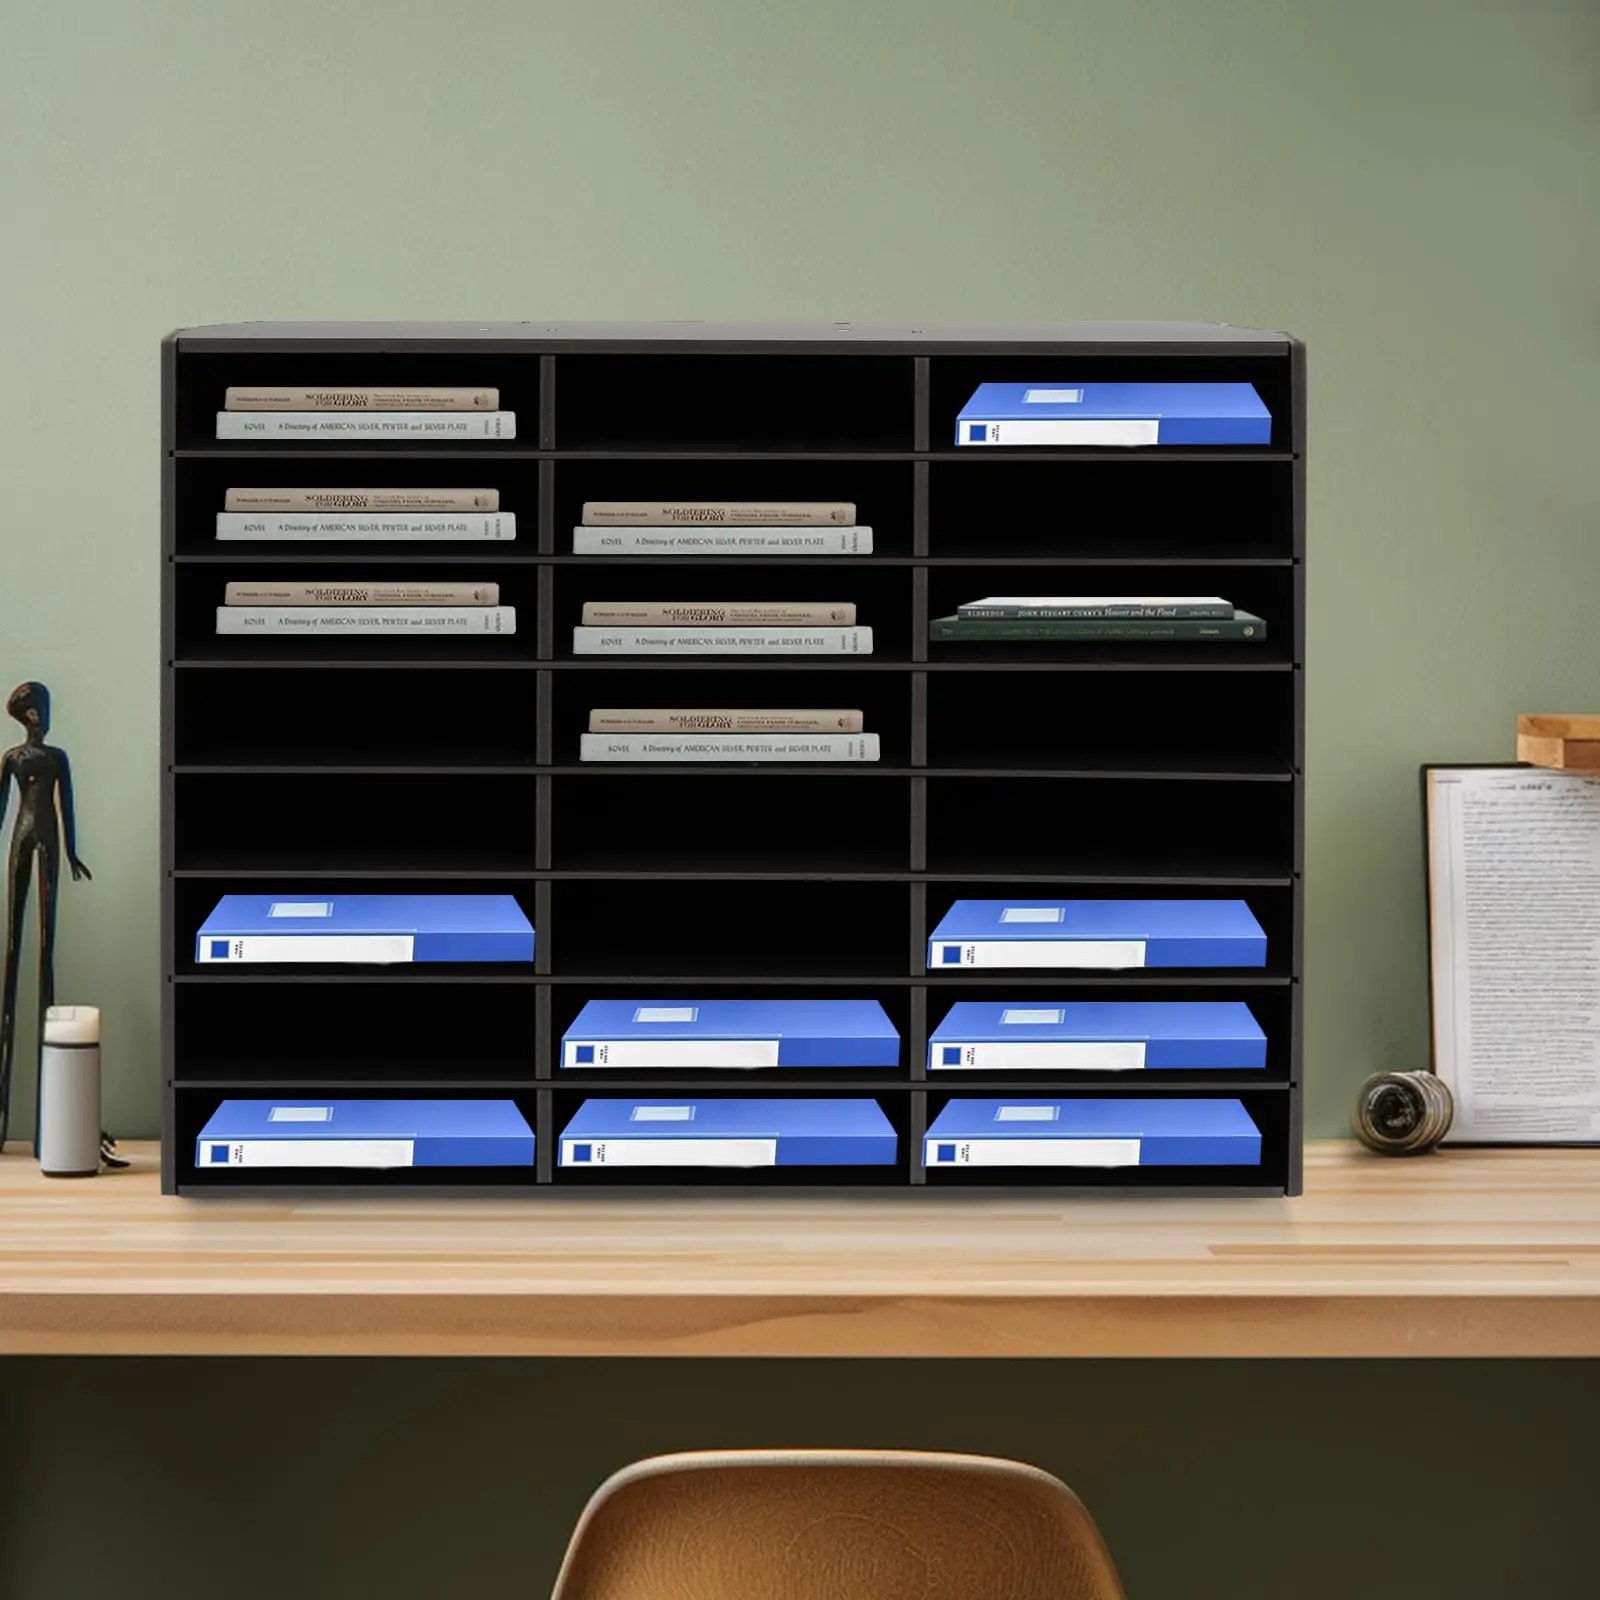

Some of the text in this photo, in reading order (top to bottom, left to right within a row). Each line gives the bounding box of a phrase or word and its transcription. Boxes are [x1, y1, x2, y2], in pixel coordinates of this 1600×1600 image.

[305, 392, 368, 400] SOLDIERING
[284, 423, 310, 432] Directory
[320, 423, 356, 431] AMERICAN
[382, 423, 408, 431] PEWTER
[305, 494, 368, 502] SOLDIERING
[334, 500, 368, 508] GLORY
[662, 508, 726, 516] SOLDIERING
[690, 514, 725, 522] GLORY
[284, 524, 310, 532] Directory
[320, 524, 356, 532] AMERICAN
[382, 524, 408, 532] PEWTER
[424, 524, 447, 532] SILVER
[448, 524, 467, 532] PLATE
[642, 538, 668, 546] Directory
[676, 538, 712, 546] AMERICAN
[739, 538, 766, 546] PEWTER
[782, 538, 804, 546] SILVER
[804, 538, 824, 546] PLATE
[305, 588, 368, 596] SOLDIERING
[334, 594, 368, 602] GLORY
[662, 608, 726, 616] SOLDIERING
[1017, 610, 1038, 618] JOHN
[1130, 608, 1143, 616] and
[1144, 608, 1155, 616] the
[1157, 607, 1176, 616] Flood
[284, 618, 310, 626] Directory
[320, 618, 356, 626] AMERICAN
[382, 618, 408, 626] PEWTER
[424, 618, 447, 626] SILVER
[448, 618, 467, 626] PLATE
[690, 614, 725, 622] GLORY
[642, 638, 668, 646] Directory
[676, 638, 712, 646] AMERICAN
[739, 638, 766, 646] PEWTER
[782, 638, 804, 646] SILVER
[804, 638, 824, 646] PLATE
[669, 714, 732, 722] SOLDIERING
[648, 745, 674, 754] Directory
[684, 745, 720, 753] AMERICAN
[746, 745, 772, 753] PEWTER
